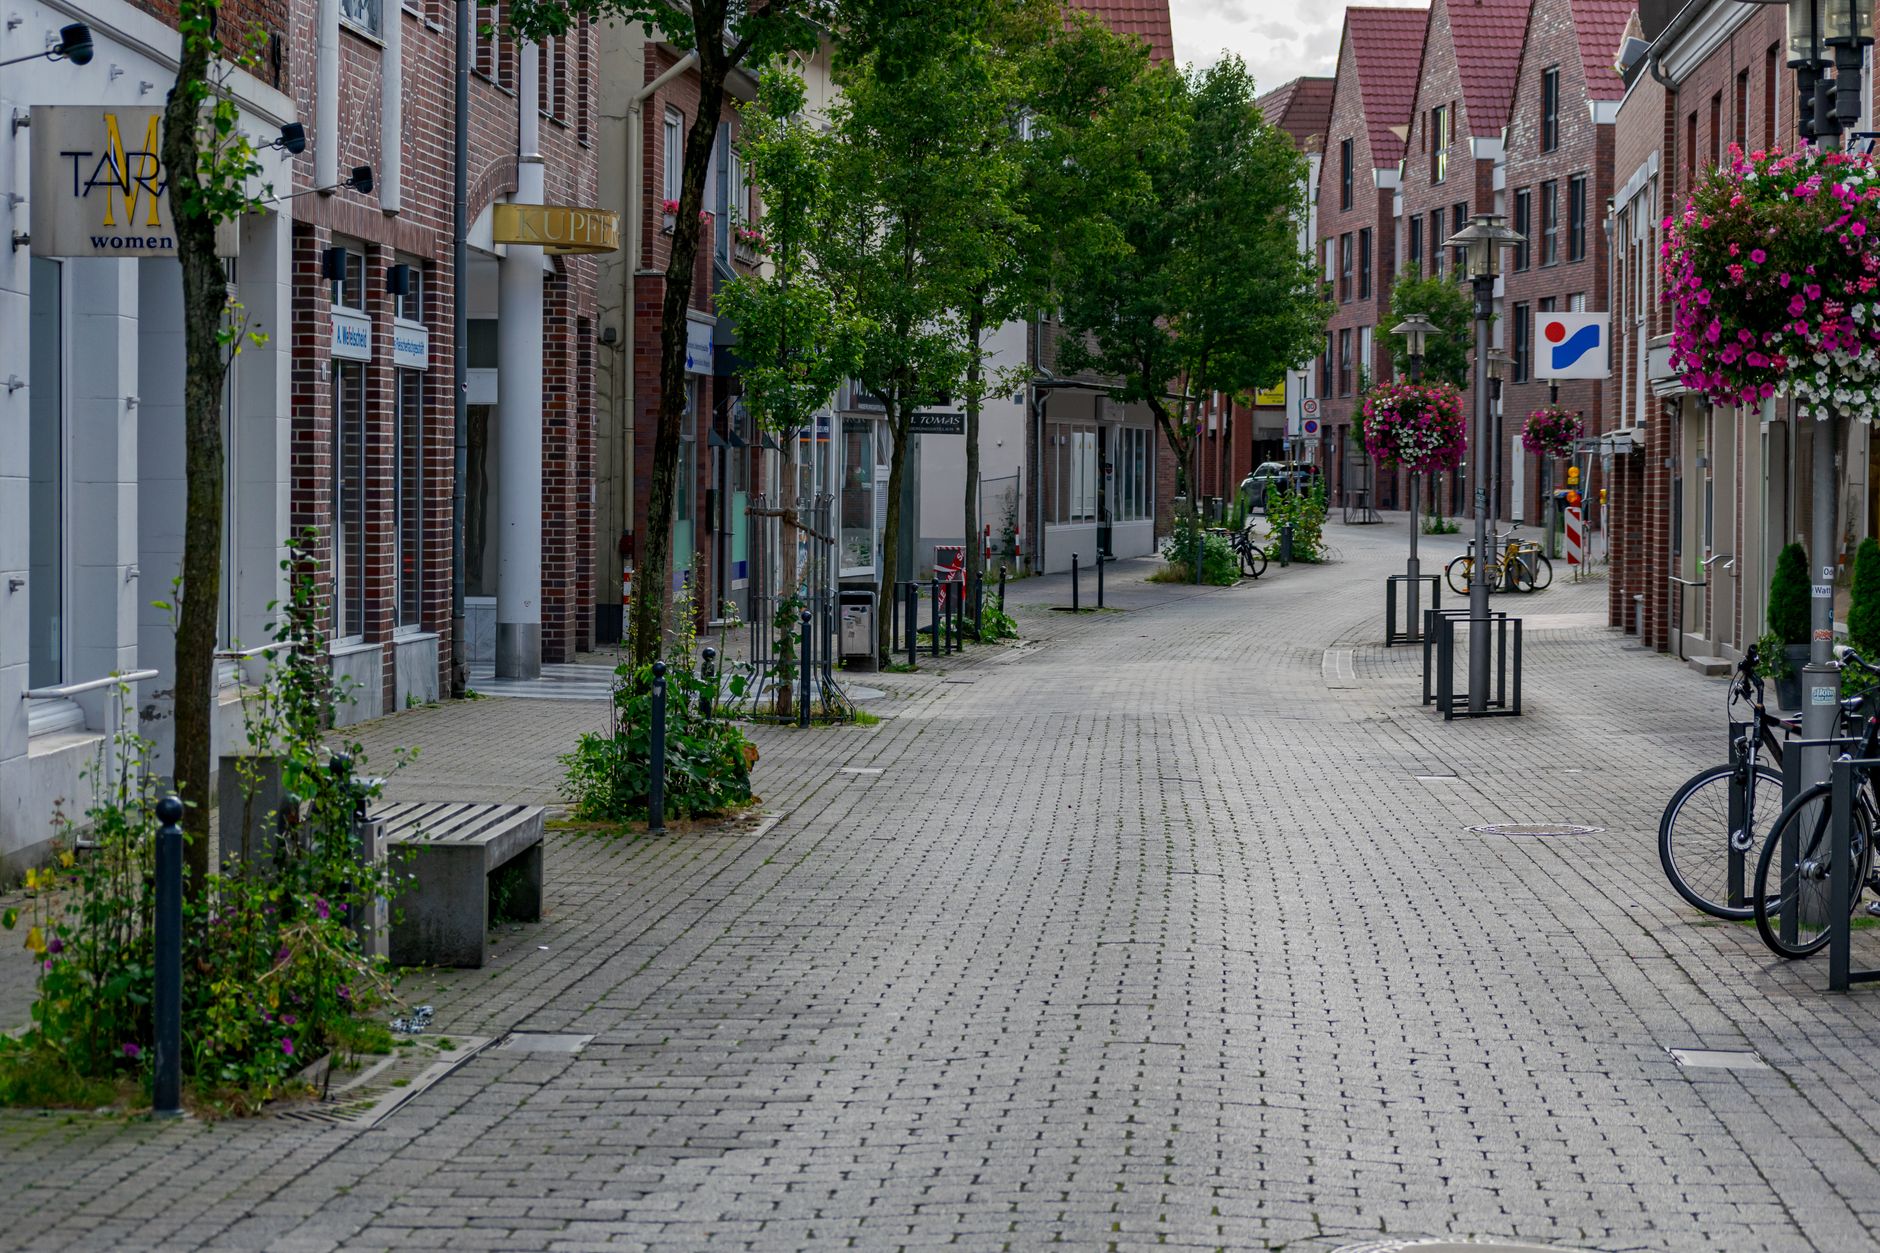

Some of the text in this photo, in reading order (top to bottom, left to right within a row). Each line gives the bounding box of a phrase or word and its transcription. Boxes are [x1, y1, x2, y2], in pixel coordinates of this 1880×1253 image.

[103, 113, 161, 227] M
[90, 235, 173, 249] women
[920, 416, 960, 425] TOMAS
